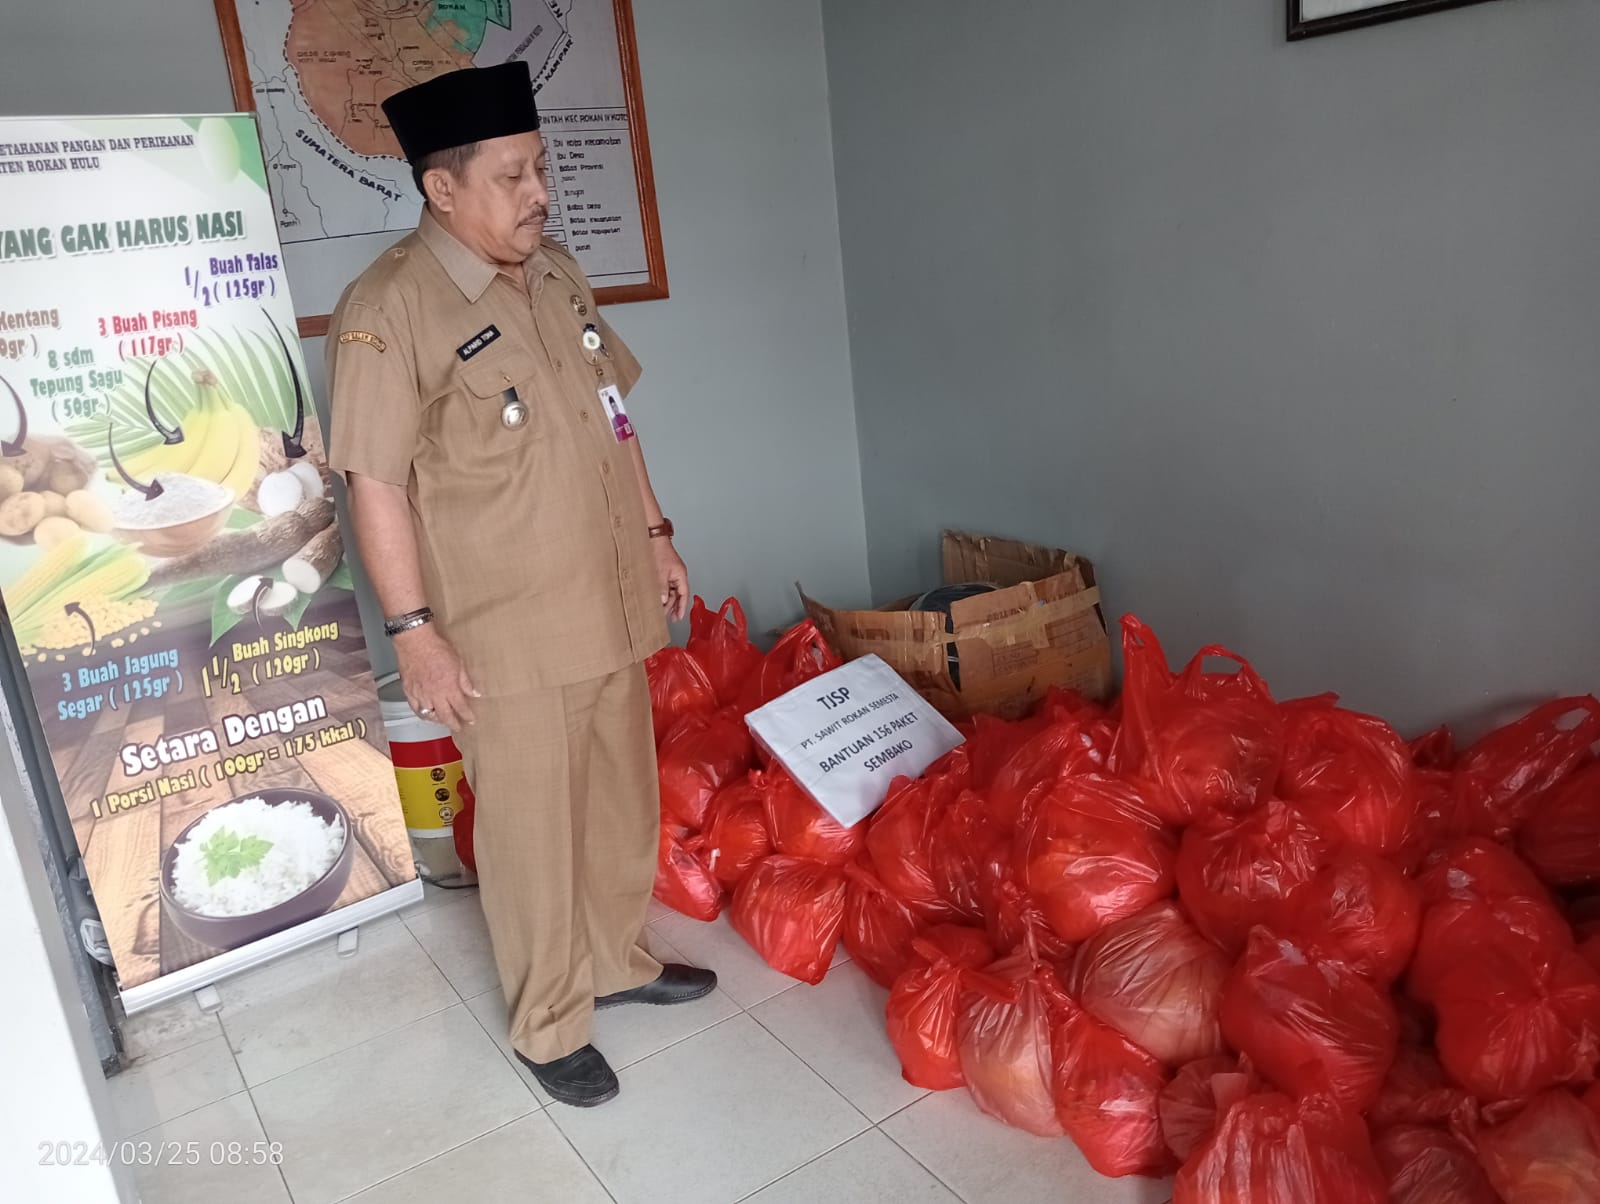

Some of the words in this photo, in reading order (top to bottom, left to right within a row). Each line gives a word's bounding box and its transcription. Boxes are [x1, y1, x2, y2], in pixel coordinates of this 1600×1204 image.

[62, 139, 107, 153] PANGAN
[110, 137, 132, 151] DAN
[134, 134, 195, 150] PERIKANAN
[27, 158, 67, 172] ROKAN
[69, 156, 100, 170] HULU
[295, 128, 355, 178] SUMATERA
[359, 175, 402, 202] BARAT
[61, 221, 109, 254] GAK
[116, 214, 190, 249] HARUS
[196, 209, 245, 240] NASI
[209, 255, 243, 276] Buah
[245, 251, 279, 272] Talas
[226, 277, 266, 300] 125gr
[98, 317, 106, 337] 3
[112, 313, 149, 336] Buah
[152, 308, 199, 330] Pisang
[48, 350, 58, 370] 8
[63, 347, 94, 368] sdm
[131, 335, 174, 358] 117gr
[30, 375, 85, 398] Tepung
[88, 367, 125, 390] Sagu
[63, 397, 99, 418] 50gr
[232, 636, 270, 663] Buah
[273, 620, 340, 651] Singkong
[62, 672, 72, 693] 3
[78, 662, 120, 688] Buah
[124, 648, 180, 677] Jagung
[265, 651, 310, 679] 120gr
[57, 693, 104, 722] Segar
[122, 675, 172, 704] 125gr
[816, 686, 852, 711] TJSP
[120, 727, 219, 777] Setara
[222, 694, 327, 746] Dengan
[801, 738, 816, 750] PT.
[814, 720, 843, 742] SAWIT
[843, 706, 870, 726] ROKAN
[868, 692, 900, 713] SEMESTA
[818, 733, 876, 774] BANTUAN
[872, 723, 893, 743] 156
[891, 711, 920, 733] PAKET
[863, 738, 914, 773] SEMBAKO
[90, 799, 101, 819] 1
[107, 782, 153, 814] Porsi
[157, 768, 197, 799] Nasi
[214, 751, 265, 783] 100gr
[285, 732, 317, 759] 175
[320, 721, 355, 747] kkal
